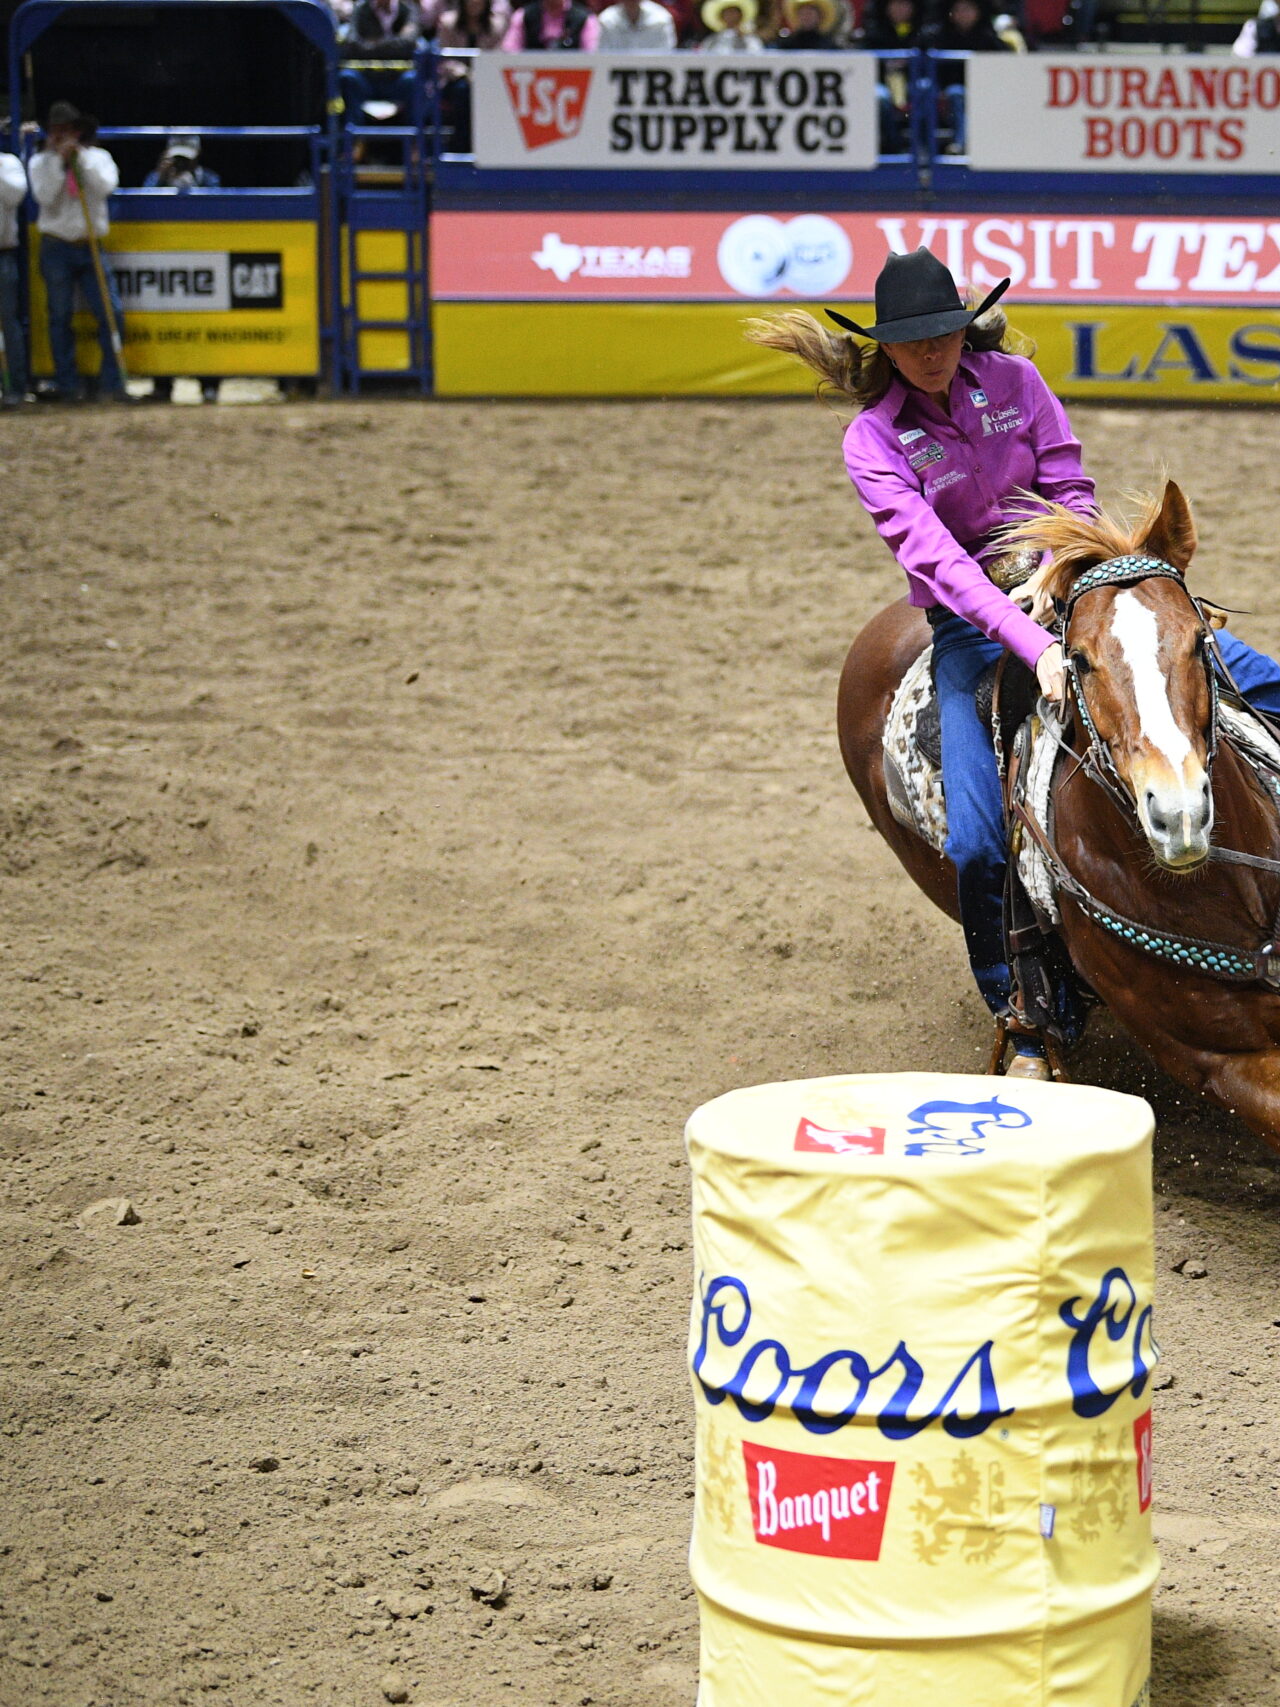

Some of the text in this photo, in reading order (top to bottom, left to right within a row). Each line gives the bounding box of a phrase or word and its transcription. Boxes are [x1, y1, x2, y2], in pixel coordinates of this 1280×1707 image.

[511, 71, 579, 134] TSC
[609, 67, 846, 109] TRACTOR
[610, 112, 784, 153] SUPPLY
[1085, 117, 1245, 160] BOOTS
[582, 245, 692, 266] TEXAS
[876, 216, 1116, 290] VISIT
[115, 263, 281, 298] MPIRE CAT
[991, 406, 1020, 421] Classic
[994, 418, 1024, 432] Equine
[693, 1275, 1016, 1440] Coors
[756, 1460, 881, 1541] Banquet
